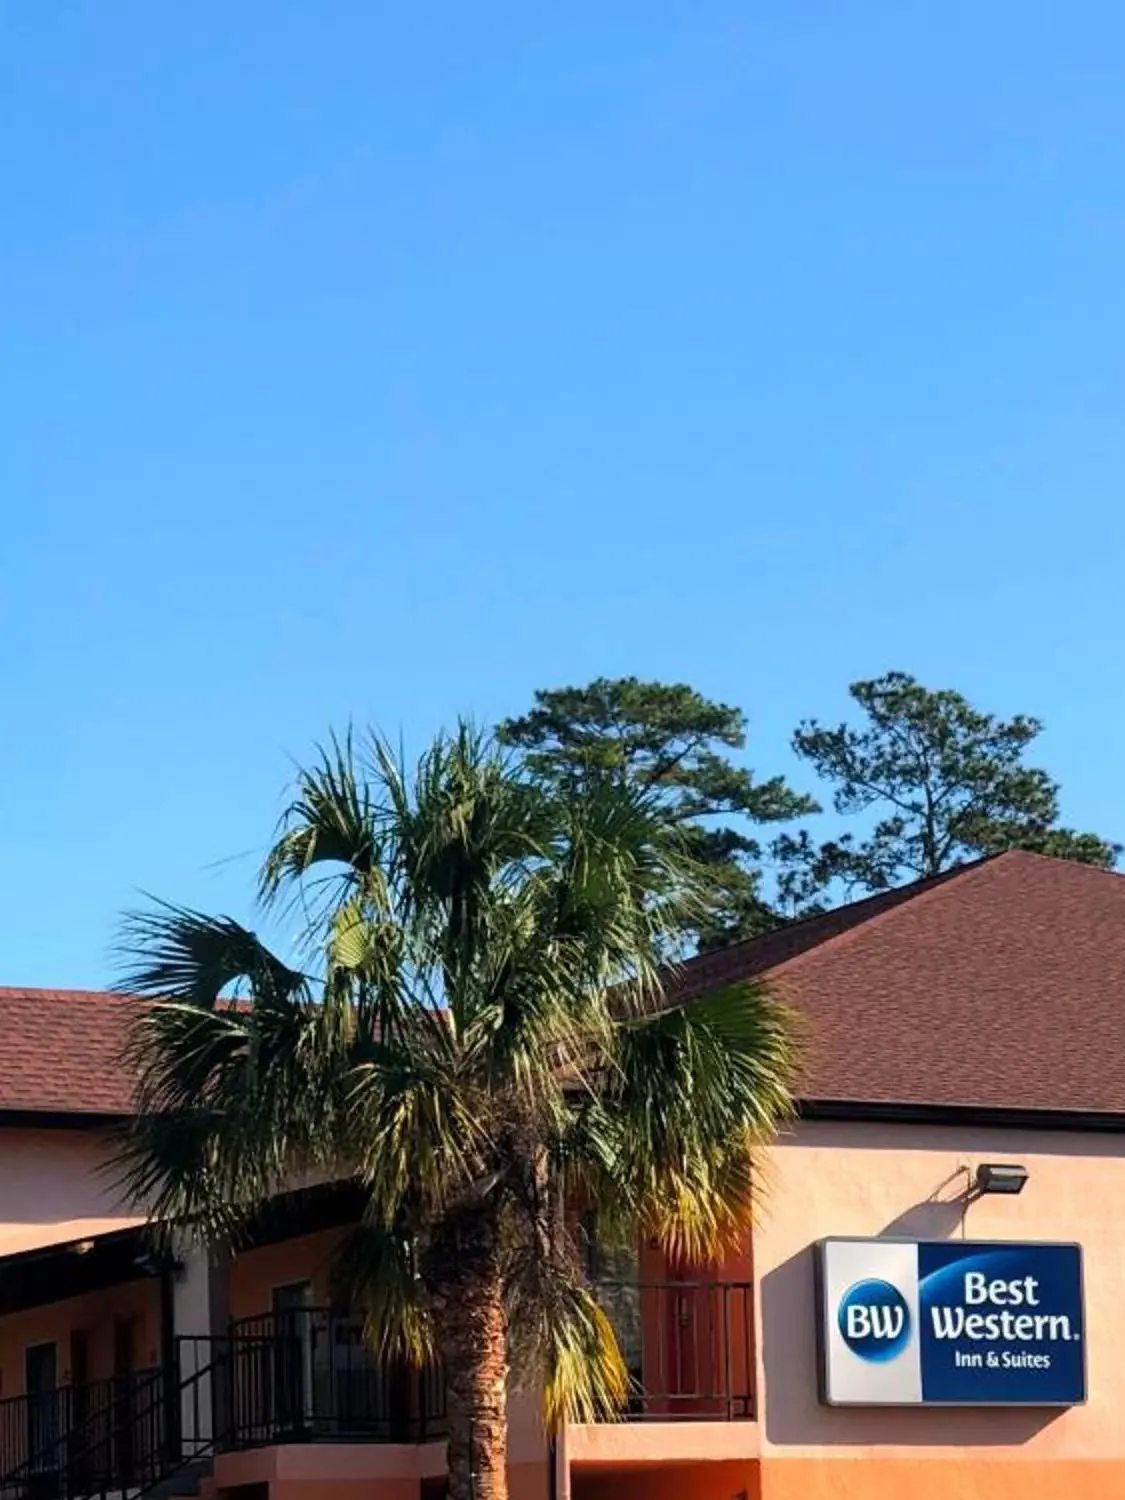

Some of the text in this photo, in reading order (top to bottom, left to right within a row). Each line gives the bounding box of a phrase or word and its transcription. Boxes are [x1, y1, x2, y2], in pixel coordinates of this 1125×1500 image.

[965, 1271, 1040, 1306] Best
[847, 1305, 904, 1339] BW
[955, 1351, 1051, 1369] Inn & Suites
